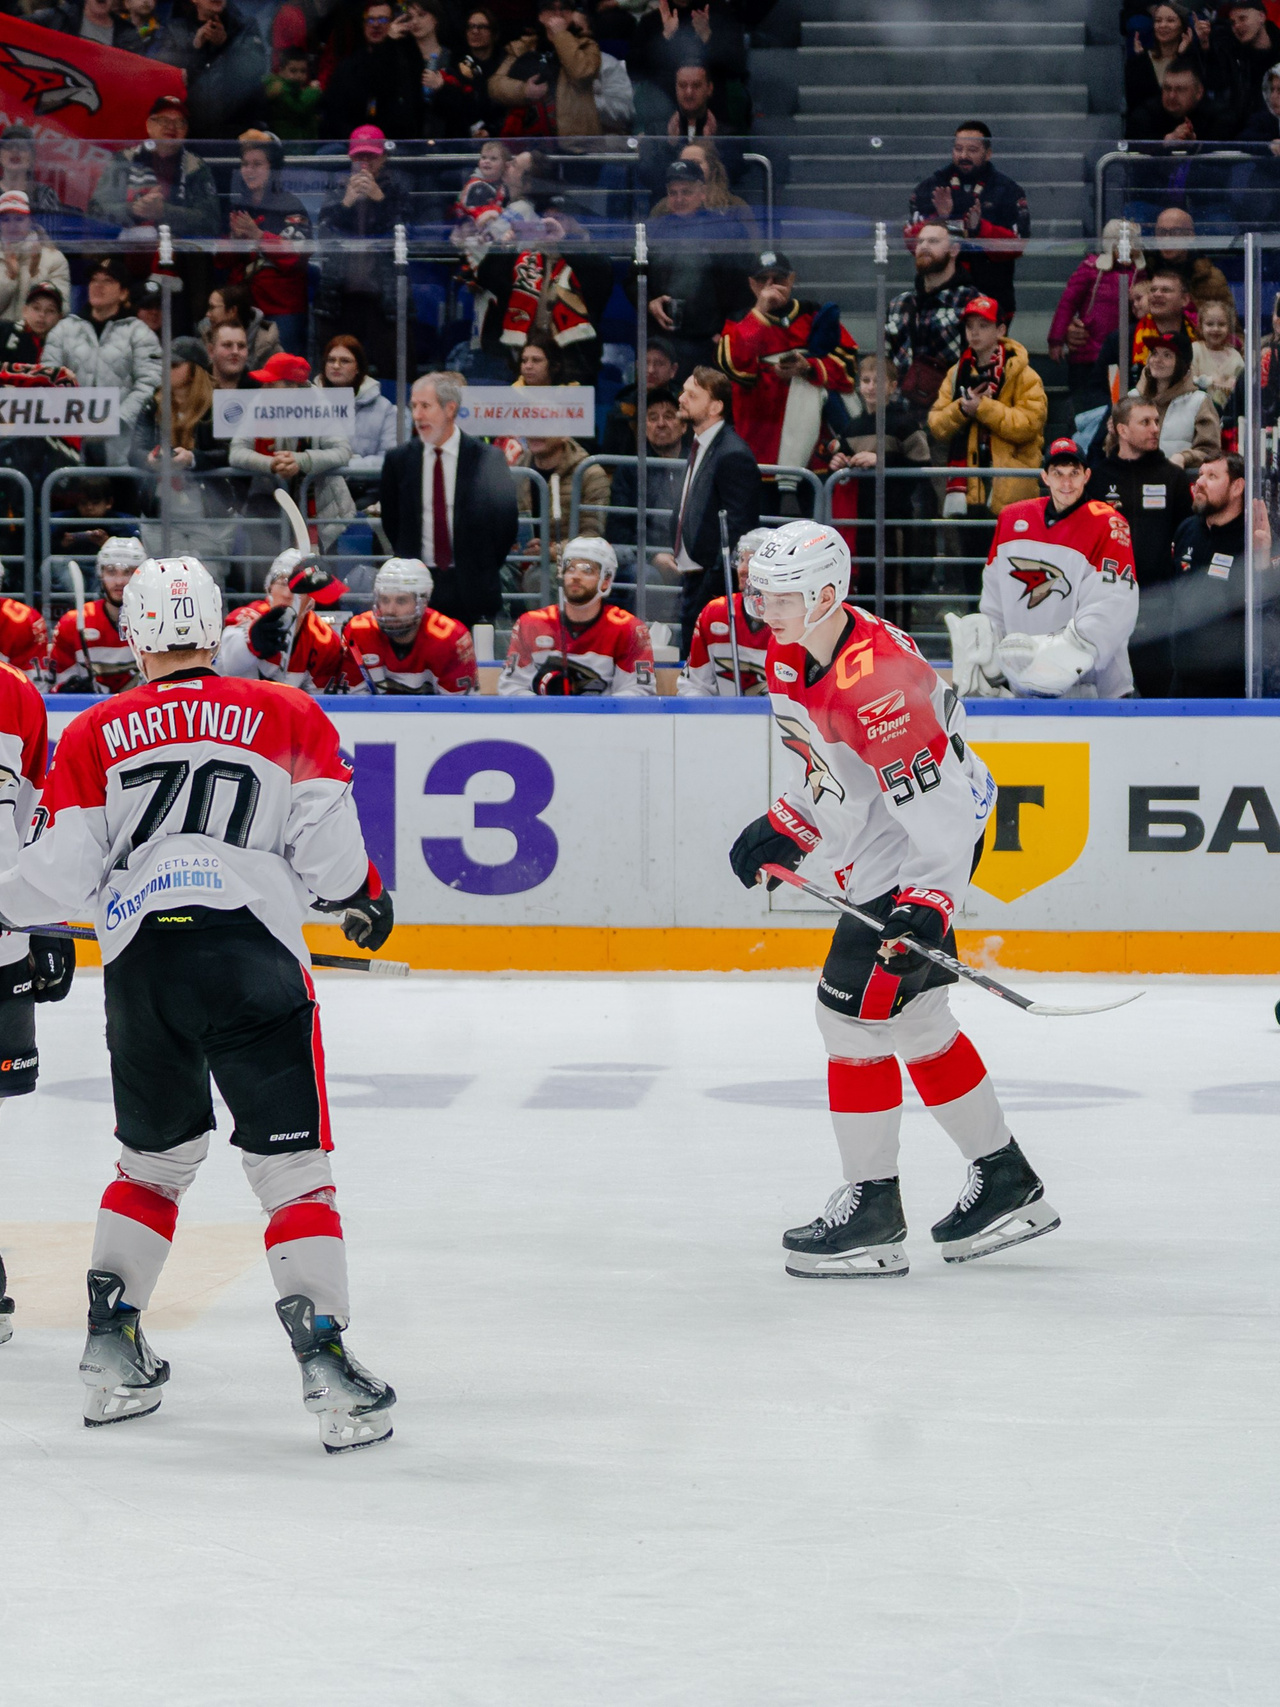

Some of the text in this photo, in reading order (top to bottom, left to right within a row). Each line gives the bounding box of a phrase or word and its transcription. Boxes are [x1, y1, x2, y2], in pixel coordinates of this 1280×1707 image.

[254, 405, 349, 420] ГАЗПРОМБАНК
[473, 406, 585, 419] T.ME/KRSCHINA
[760, 543, 781, 559] 56
[170, 582, 188, 590] FON
[1102, 558, 1137, 592] 54
[171, 588, 188, 596] BET
[170, 597, 196, 620] 70
[102, 700, 264, 759] MARTYNOV
[881, 728, 908, 744] АРЕНА
[880, 747, 942, 807] 56
[112, 758, 261, 870] 70
[771, 802, 822, 848] BAUER
[156, 858, 219, 873] СЕТЬ АЗС
[119, 871, 223, 921] ГАЗПРОМНЕФТЬ
[908, 888, 954, 920] BAU
[819, 976, 853, 1001] ENERGY
[269, 1131, 310, 1142] BAUER
